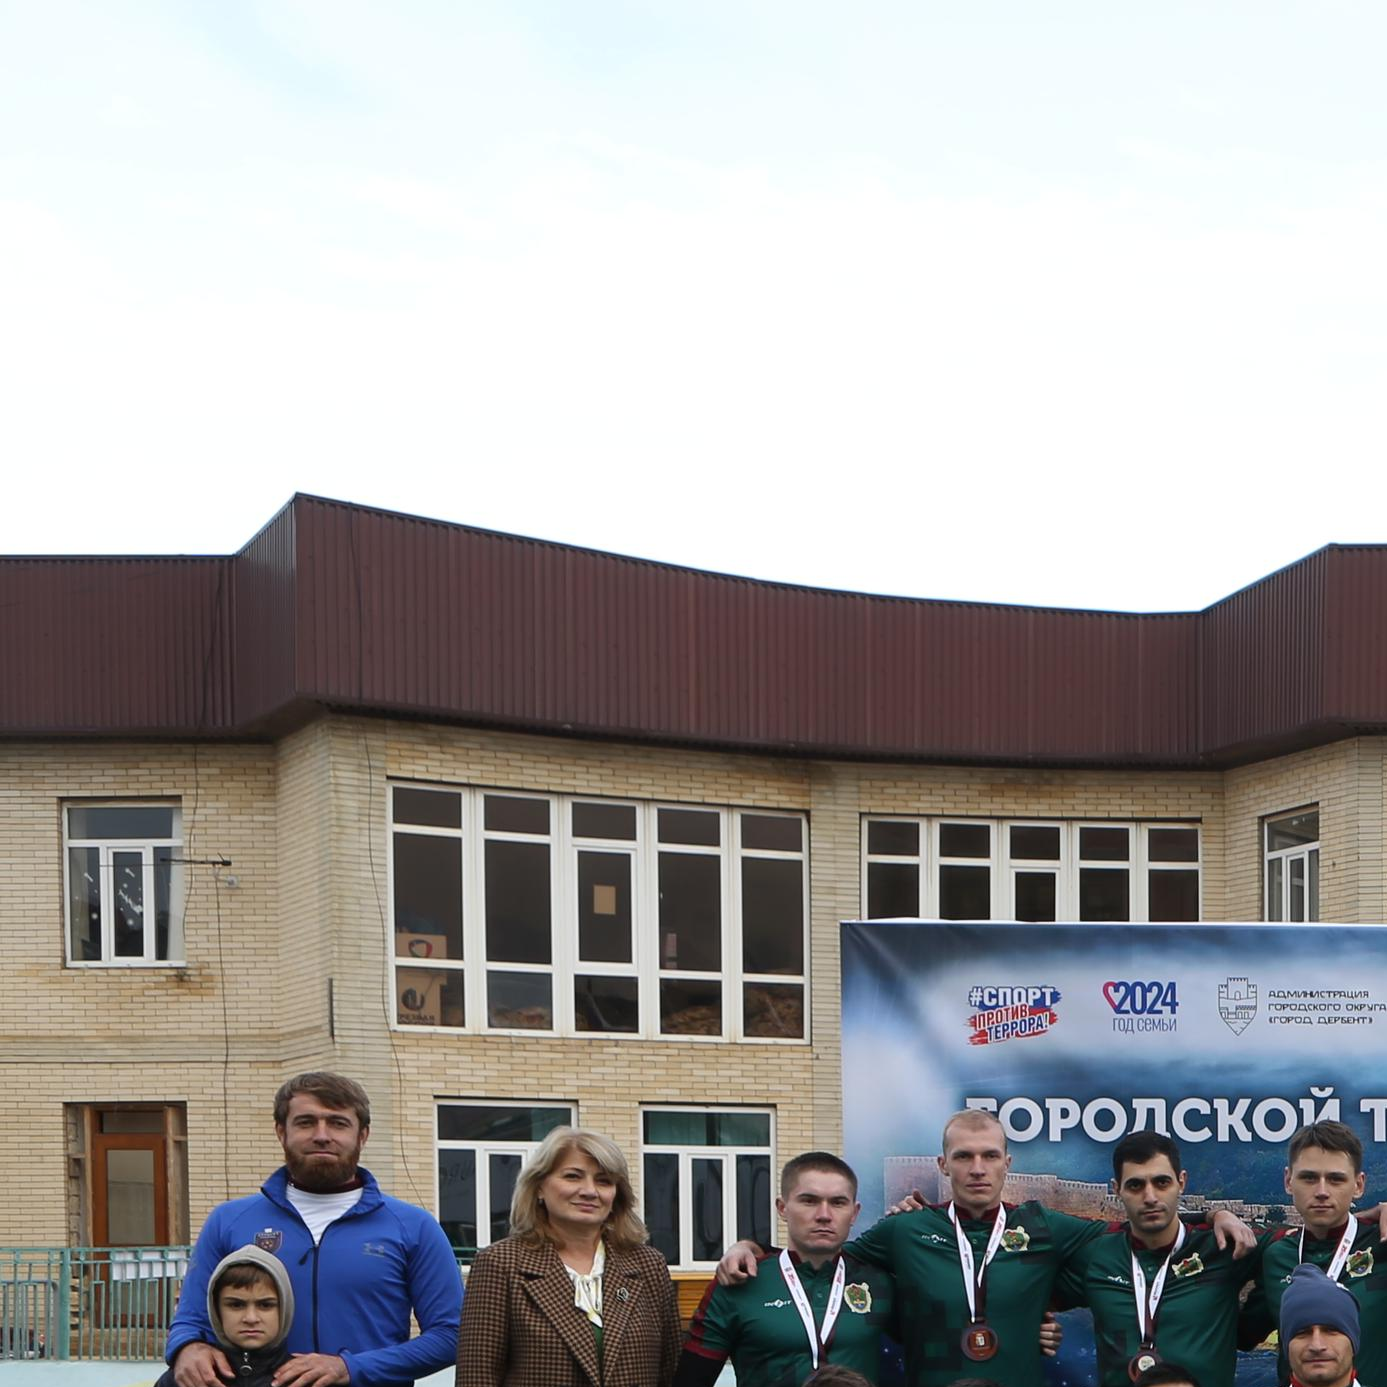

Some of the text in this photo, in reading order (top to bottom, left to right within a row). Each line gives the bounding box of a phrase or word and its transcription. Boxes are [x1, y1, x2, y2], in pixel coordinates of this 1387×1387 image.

[969, 987, 1055, 1008] #СПОРТ
[1113, 981, 1179, 1015] 2024
[1268, 990, 1369, 1000] АДМИНИСТРАЦИЯ
[977, 1004, 1028, 1030] ПРОТИВ
[1268, 1003, 1387, 1012] ГОРОДСКОГО ОКРУГА
[987, 1014, 1049, 1042] ТЕРРОРА!
[1112, 1018, 1135, 1034] ГОД
